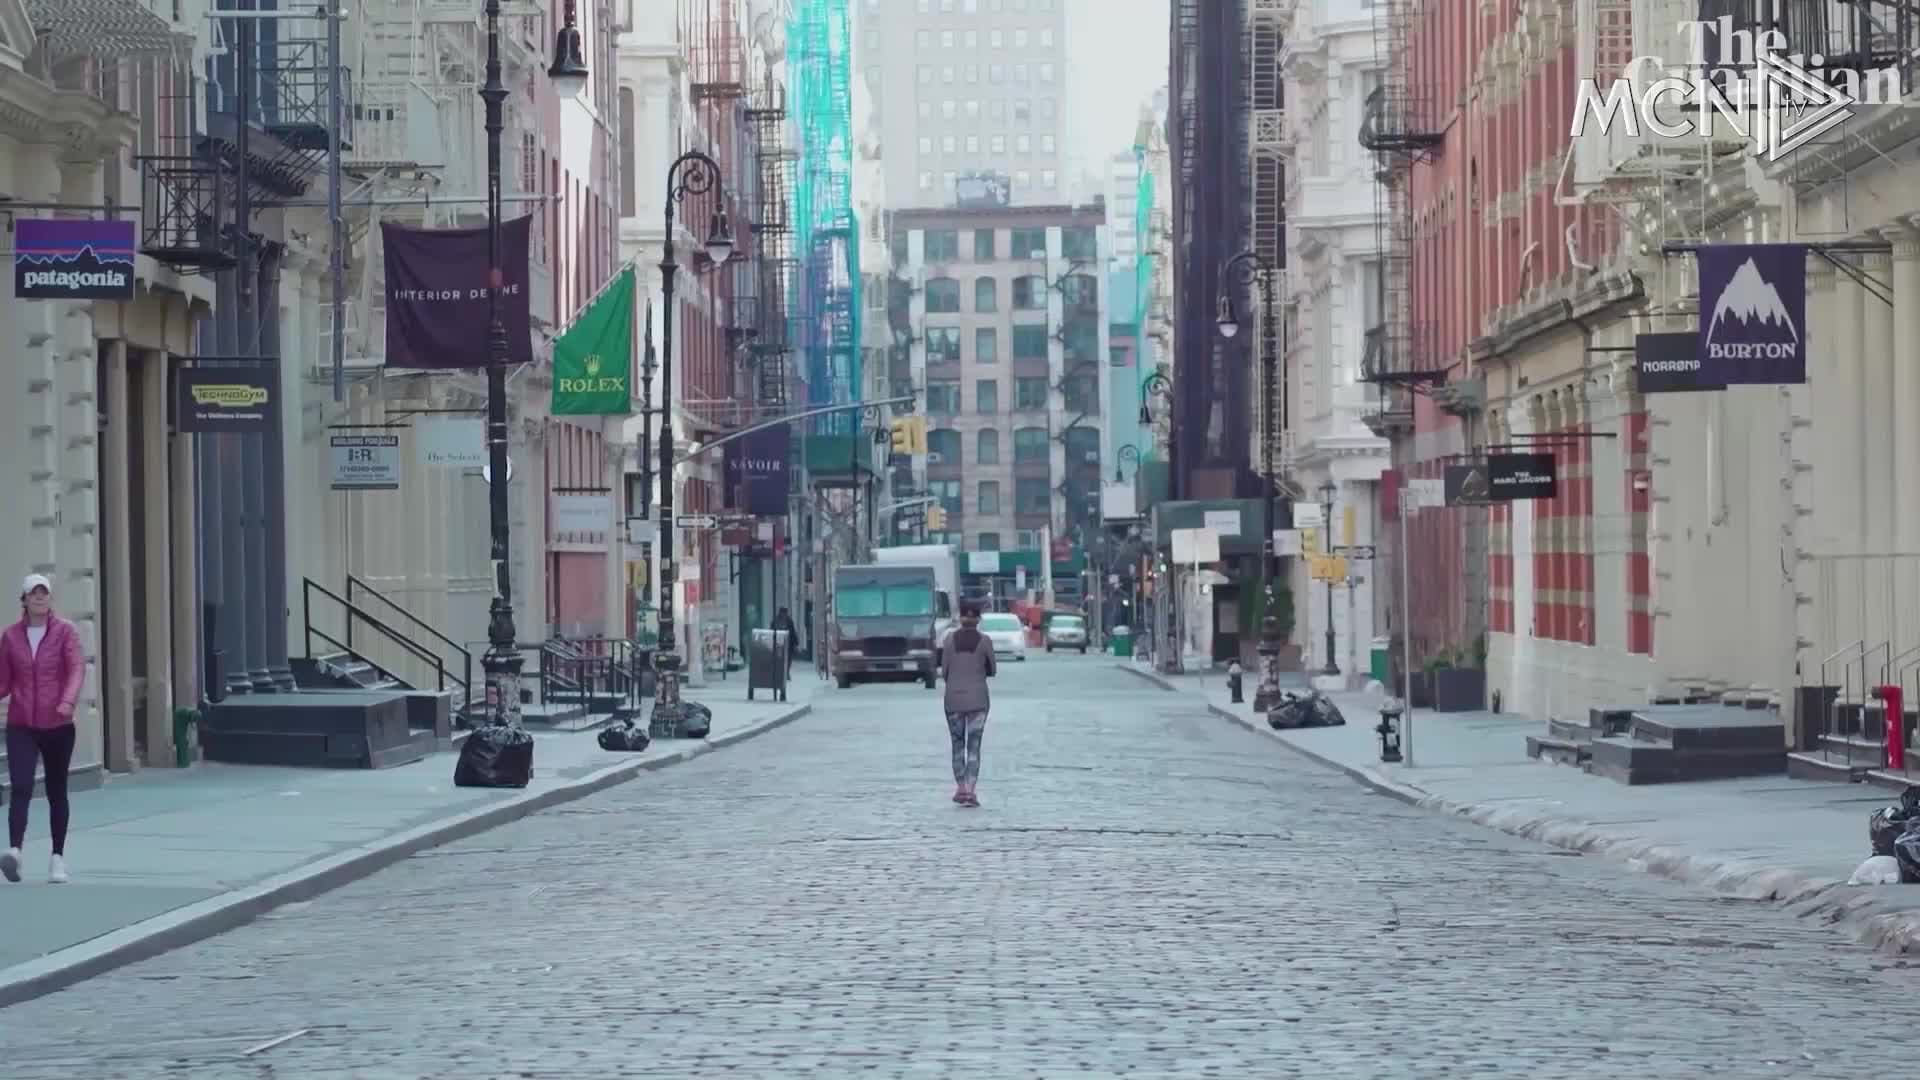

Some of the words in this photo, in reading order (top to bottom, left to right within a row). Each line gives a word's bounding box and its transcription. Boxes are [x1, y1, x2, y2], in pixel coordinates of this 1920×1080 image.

[24, 269, 126, 290] patagonia
[394, 289, 461, 301] INTERIOR
[469, 284, 519, 299] DENE
[1709, 343, 1796, 359] BURTON
[559, 377, 625, 393] ROLEX
[729, 459, 781, 472] SAVOIR
